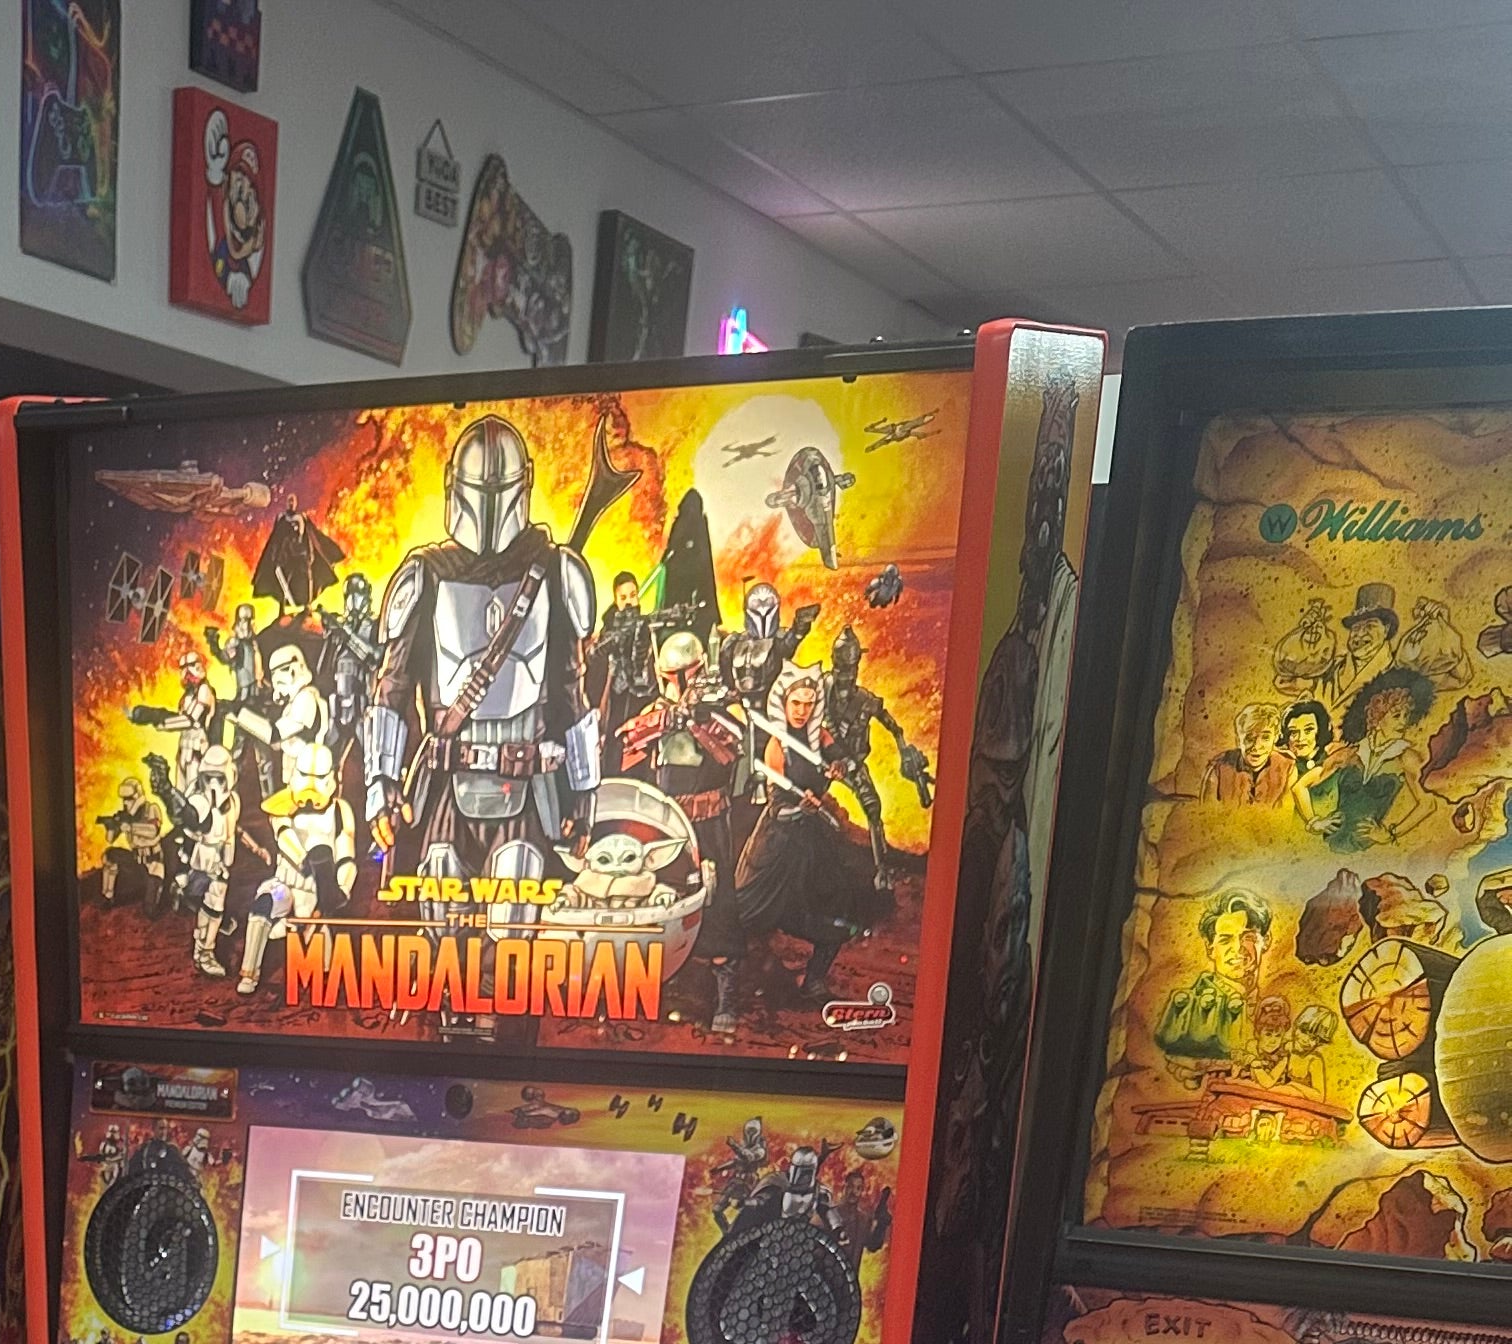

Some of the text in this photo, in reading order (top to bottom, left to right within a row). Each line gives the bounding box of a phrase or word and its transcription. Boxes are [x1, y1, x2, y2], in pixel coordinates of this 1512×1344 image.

[1299, 498, 1484, 545] Williams
[378, 876, 563, 905] STAR WARS
[447, 912, 486, 929] THE
[287, 934, 663, 1020] MANDALORIAN
[832, 1006, 887, 1021] Stern
[340, 1192, 565, 1238] ENCOUNTER CHAMPION
[408, 1234, 482, 1284] 3PO
[347, 1282, 538, 1339] 25,000,000
[1144, 1312, 1213, 1339] EXIT
